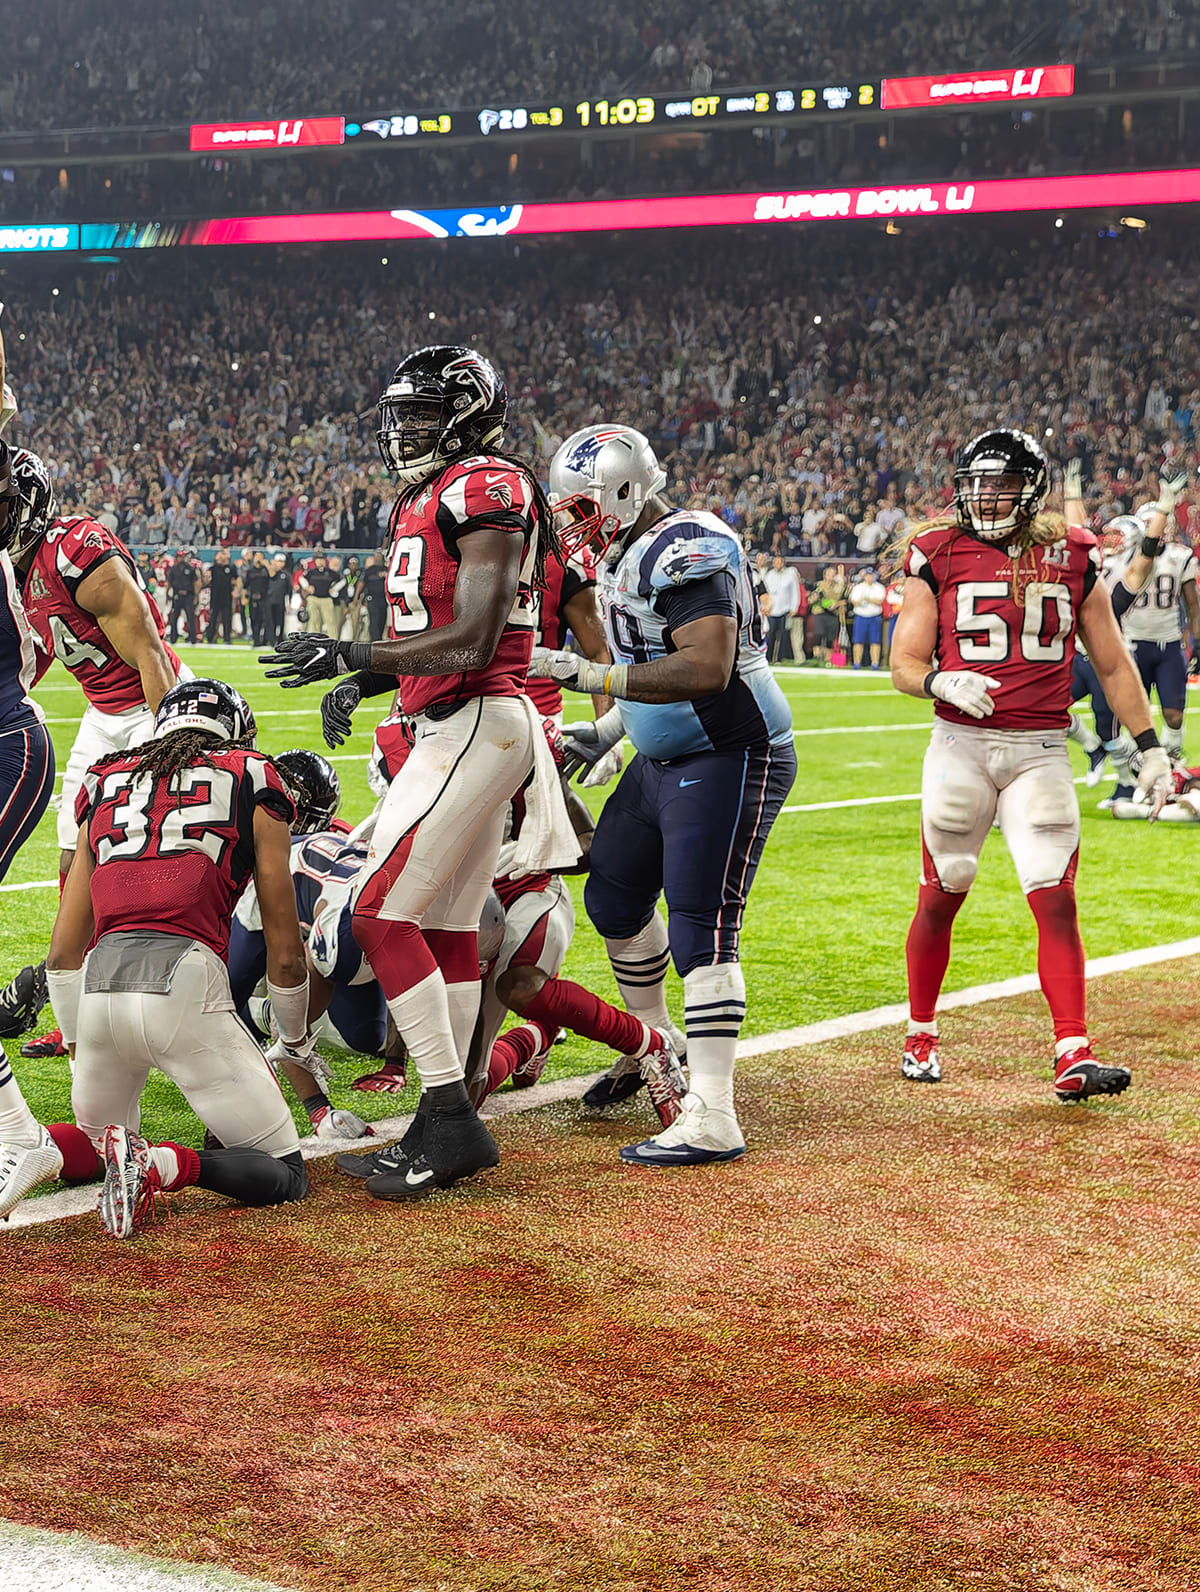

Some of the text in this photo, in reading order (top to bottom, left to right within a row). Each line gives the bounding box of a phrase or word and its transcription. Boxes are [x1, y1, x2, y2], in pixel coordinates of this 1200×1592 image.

[576, 97, 655, 126] 11:03
[692, 96, 720, 117] OT
[754, 186, 975, 219] SUPER BOWL LI
[956, 582, 1073, 662] 50
[97, 766, 236, 865] 32
